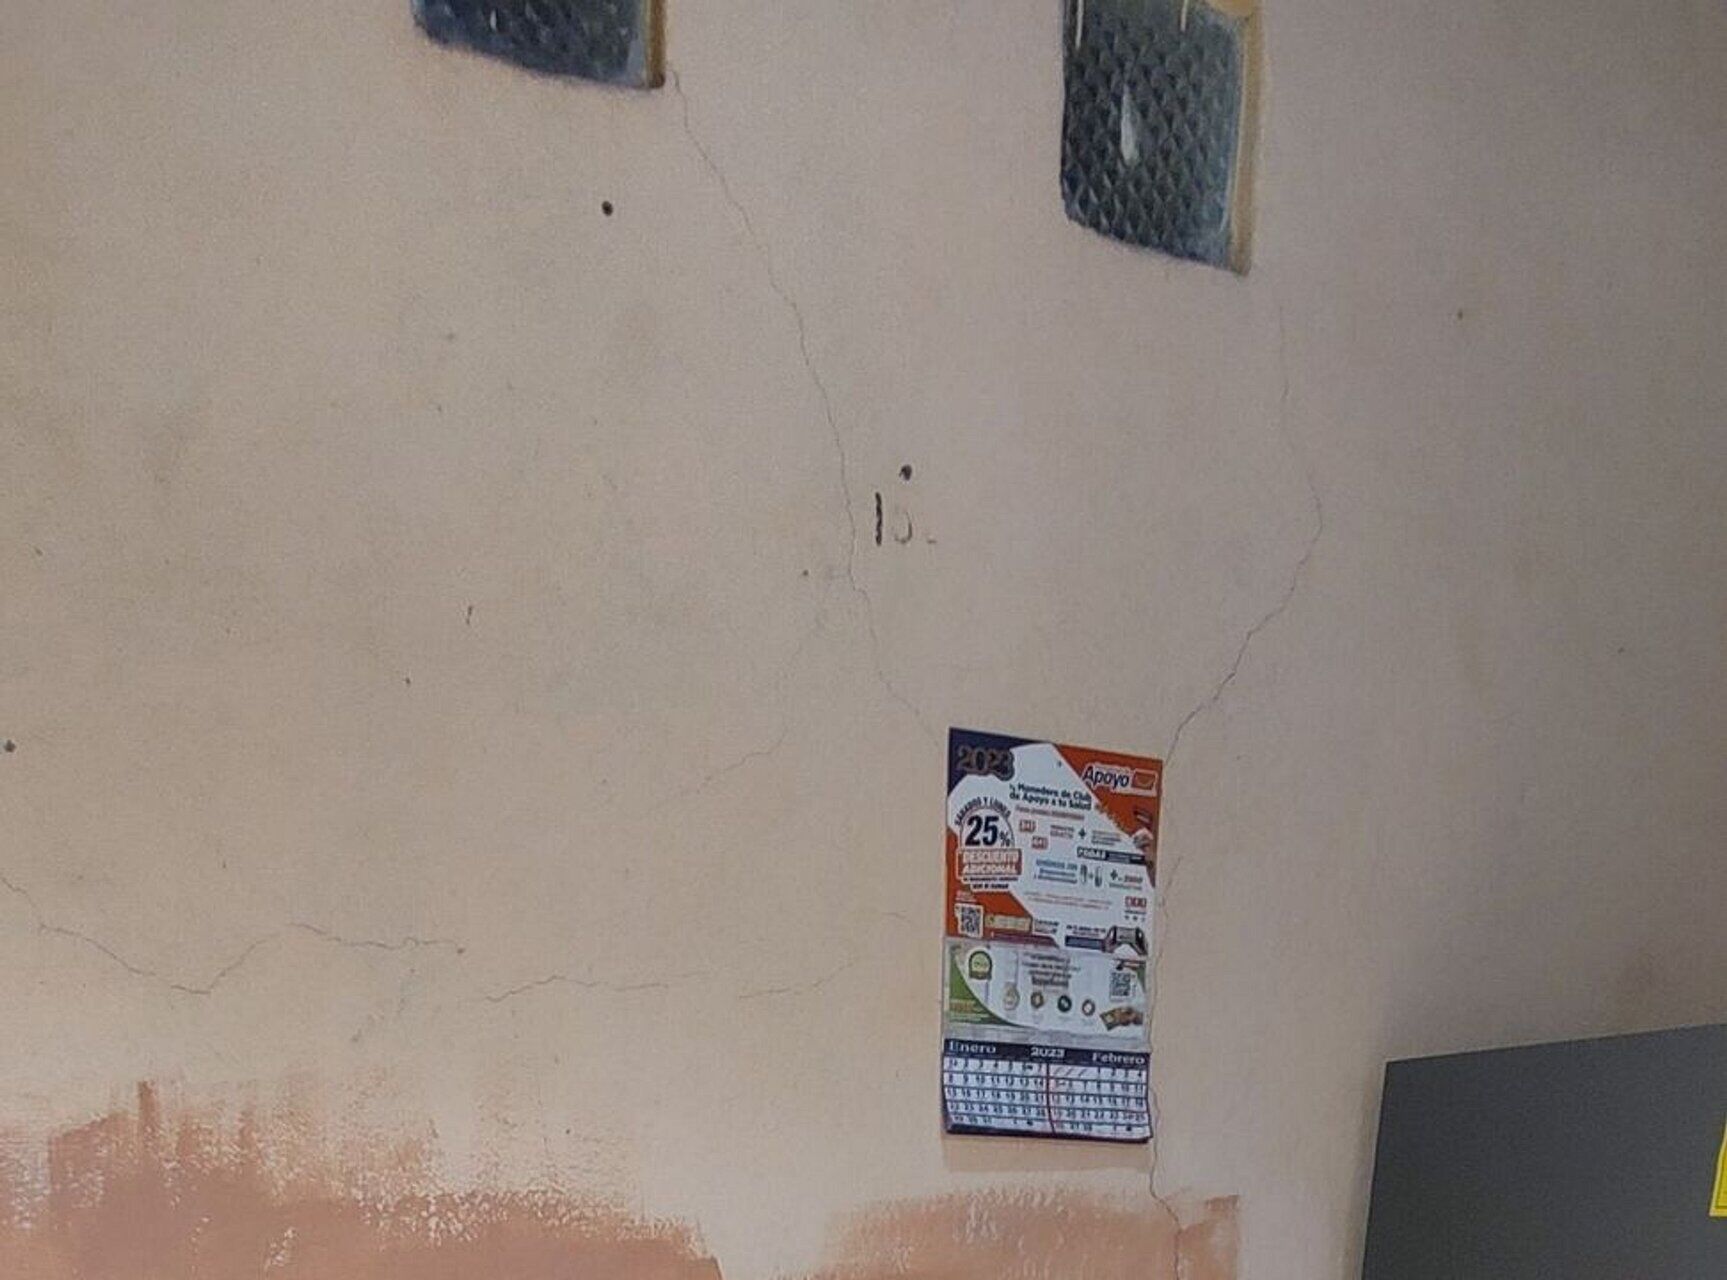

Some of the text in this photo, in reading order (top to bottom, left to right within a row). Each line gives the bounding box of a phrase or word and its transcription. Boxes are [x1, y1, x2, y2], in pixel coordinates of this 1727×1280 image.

[1082, 765, 1130, 789] Apoyo
[949, 1041, 1146, 1065] Enero 2023 Febrero
